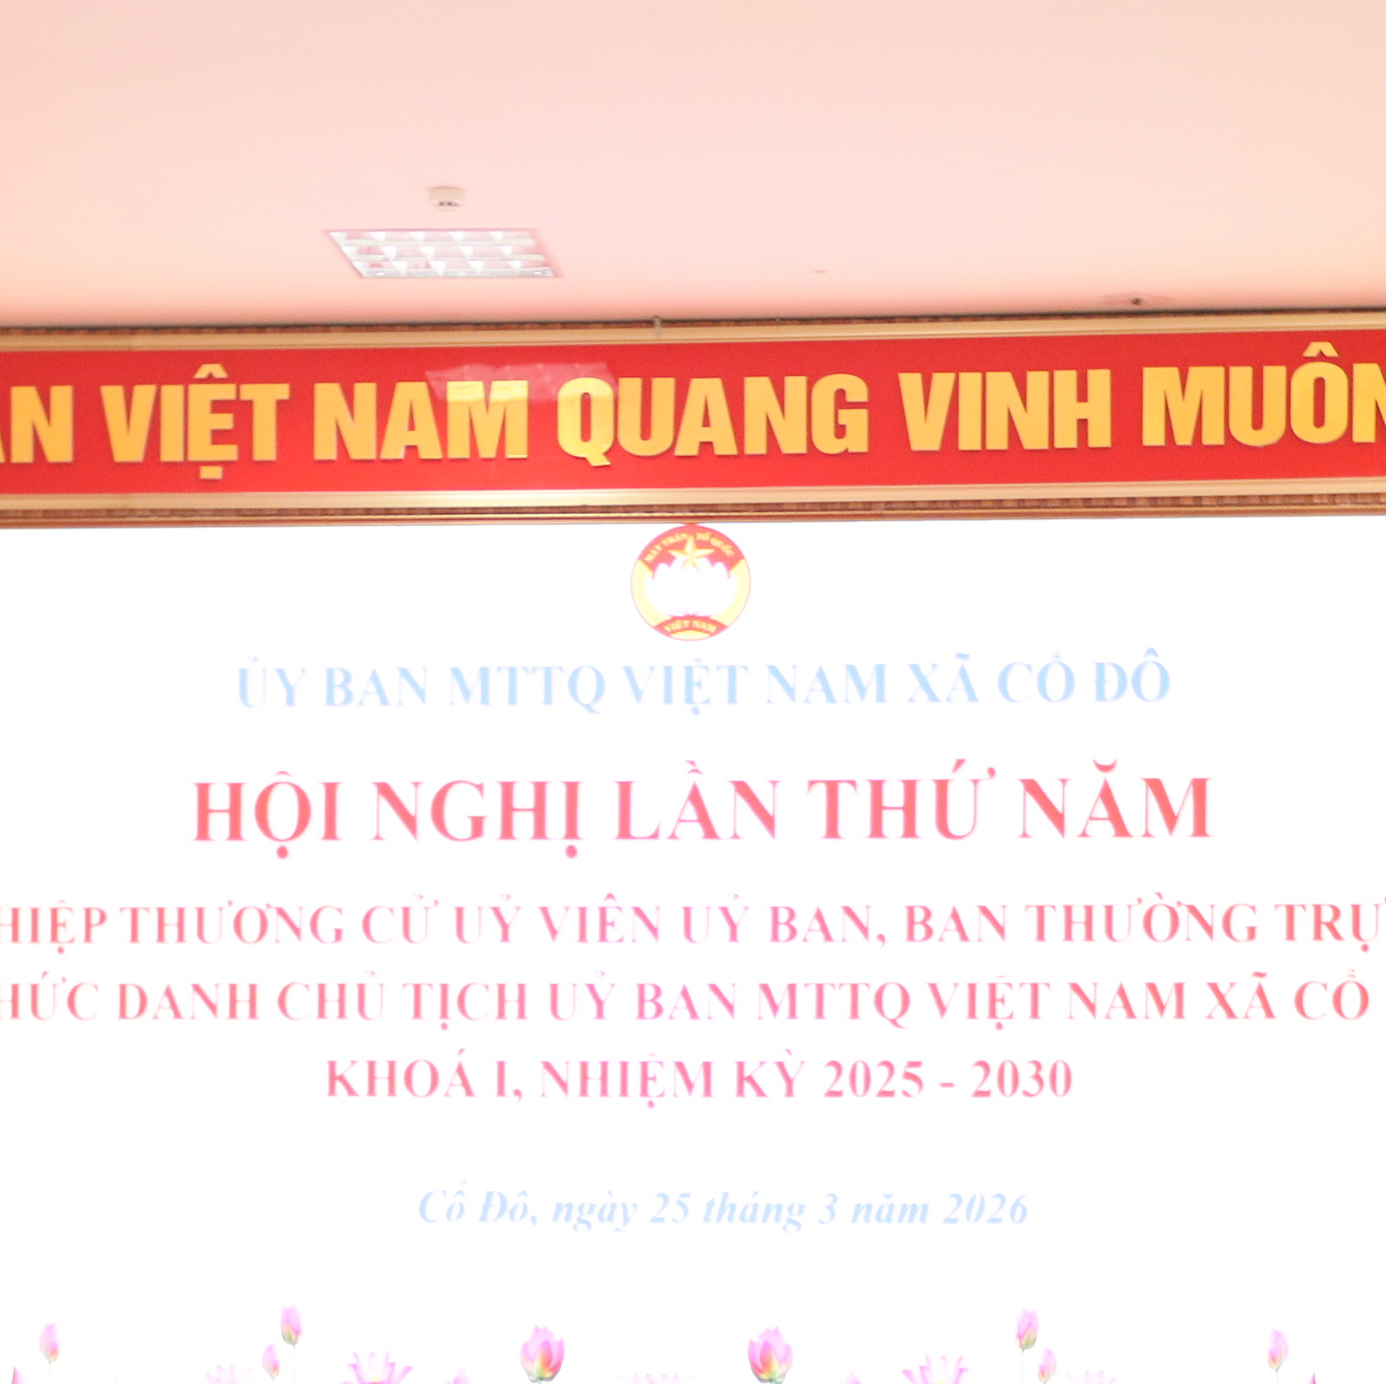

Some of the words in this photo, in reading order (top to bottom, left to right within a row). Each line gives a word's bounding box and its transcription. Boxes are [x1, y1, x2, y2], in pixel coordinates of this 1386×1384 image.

[100, 363, 291, 480] VIỆT
[313, 380, 529, 461] NAM
[556, 373, 870, 467] QUANG
[898, 368, 1113, 452] VINH
[238, 656, 306, 708] ỦY
[325, 667, 427, 707] BAN
[450, 665, 606, 714] MTTQ
[622, 658, 748, 716] VIỆT
[766, 664, 887, 704] NAM
[907, 653, 979, 703] XÃ
[997, 653, 1075, 704] CỔ
[1094, 648, 1171, 702] ĐÔ
[191, 770, 343, 860] HỘI
[370, 779, 584, 860] NGHỊ
[613, 760, 781, 840] LẦN
[807, 758, 997, 841] THỨ
[1016, 759, 1213, 840] NĂM
[119, 899, 344, 944] THƯƠNG
[361, 894, 440, 944] CỬ
[453, 894, 522, 944] UỶ
[538, 892, 661, 944] VIÊN
[681, 894, 750, 944] UỶ
[769, 905, 887, 948] BAN,
[904, 904, 1008, 943] BAN
[1024, 891, 1258, 943] THƯỜNG
[117, 983, 259, 1020] DANH
[277, 970, 385, 1021] CHỦ
[402, 982, 528, 1031] TỊCH
[549, 970, 616, 1021] UỶ
[635, 983, 737, 1021] BAN
[757, 982, 911, 1029] MTTQ
[926, 976, 1051, 1031] VIỆT
[1067, 982, 1186, 1020] NAM
[1205, 971, 1277, 1020] XÃ
[1293, 969, 1371, 1021] CỔ
[326, 1048, 476, 1098] KHOÁ
[495, 1060, 523, 1104] I,
[540, 1053, 714, 1110] NHIỆM
[734, 1048, 806, 1098] KỲ
[823, 1059, 924, 1098] 2025
[970, 1059, 1073, 1098] 2030
[479, 1190, 537, 1226] Đô,
[552, 1192, 638, 1232] ngày
[650, 1193, 692, 1224] 25
[703, 1192, 806, 1232] tháng
[818, 1193, 838, 1224] 3
[852, 1194, 929, 1224] năm
[943, 1193, 1028, 1224] 2026
